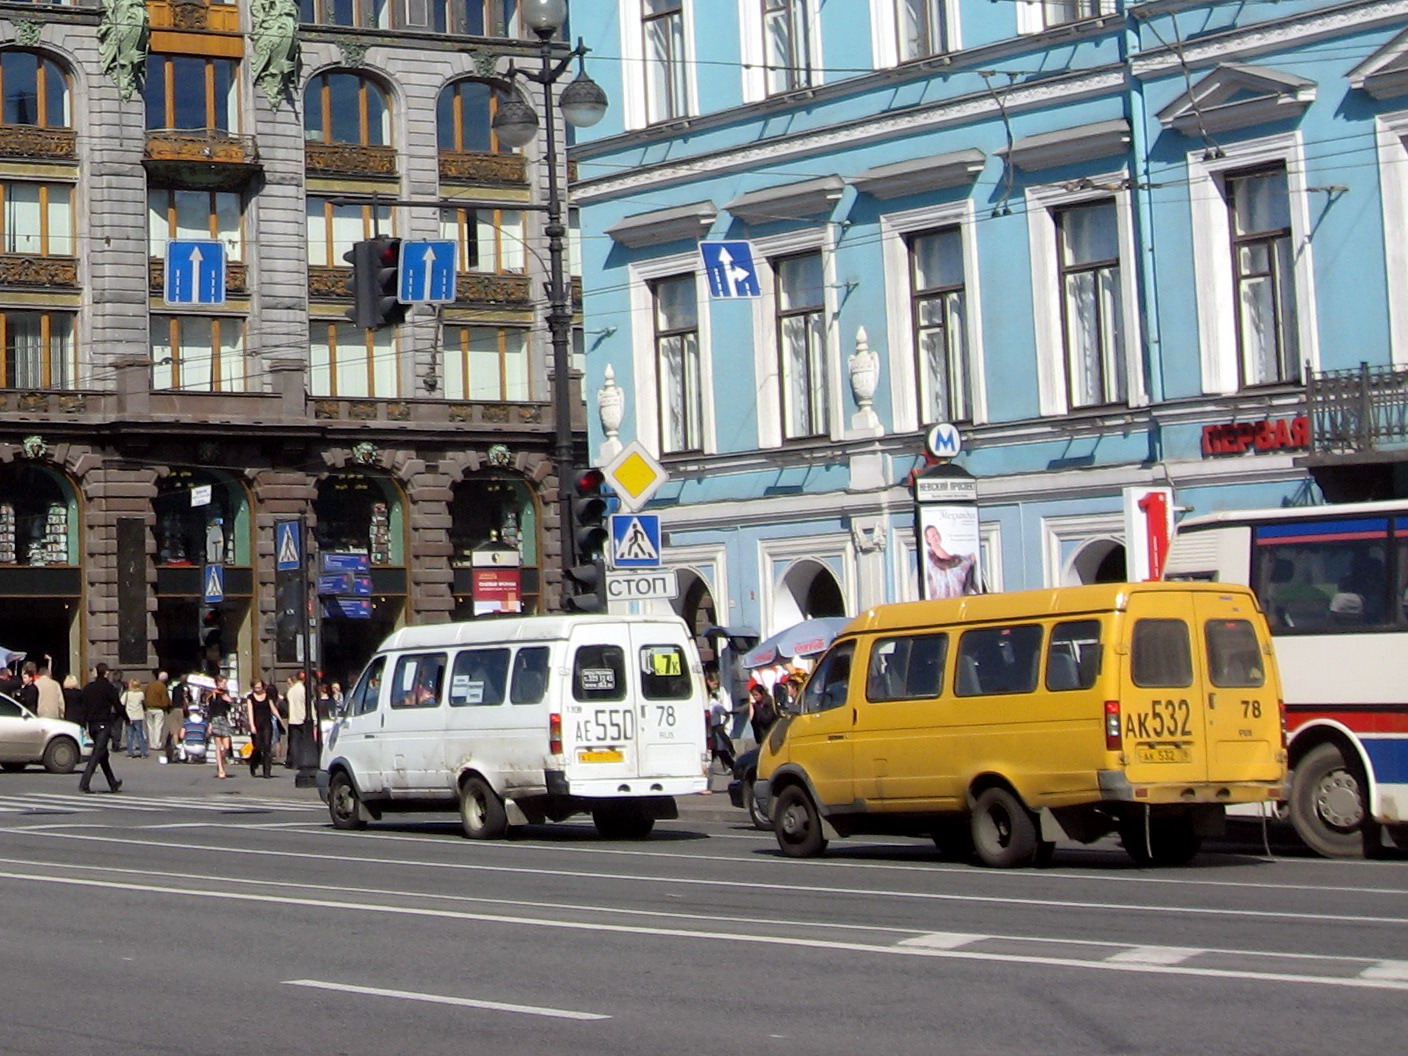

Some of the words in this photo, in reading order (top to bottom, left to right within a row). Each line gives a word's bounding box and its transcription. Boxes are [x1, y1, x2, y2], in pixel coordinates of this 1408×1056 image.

[1201, 417, 1310, 454] ПЕРВАЯ
[608, 577, 666, 597] СТОП
[656, 706, 677, 727] 78
[1241, 700, 1261, 718] 78
